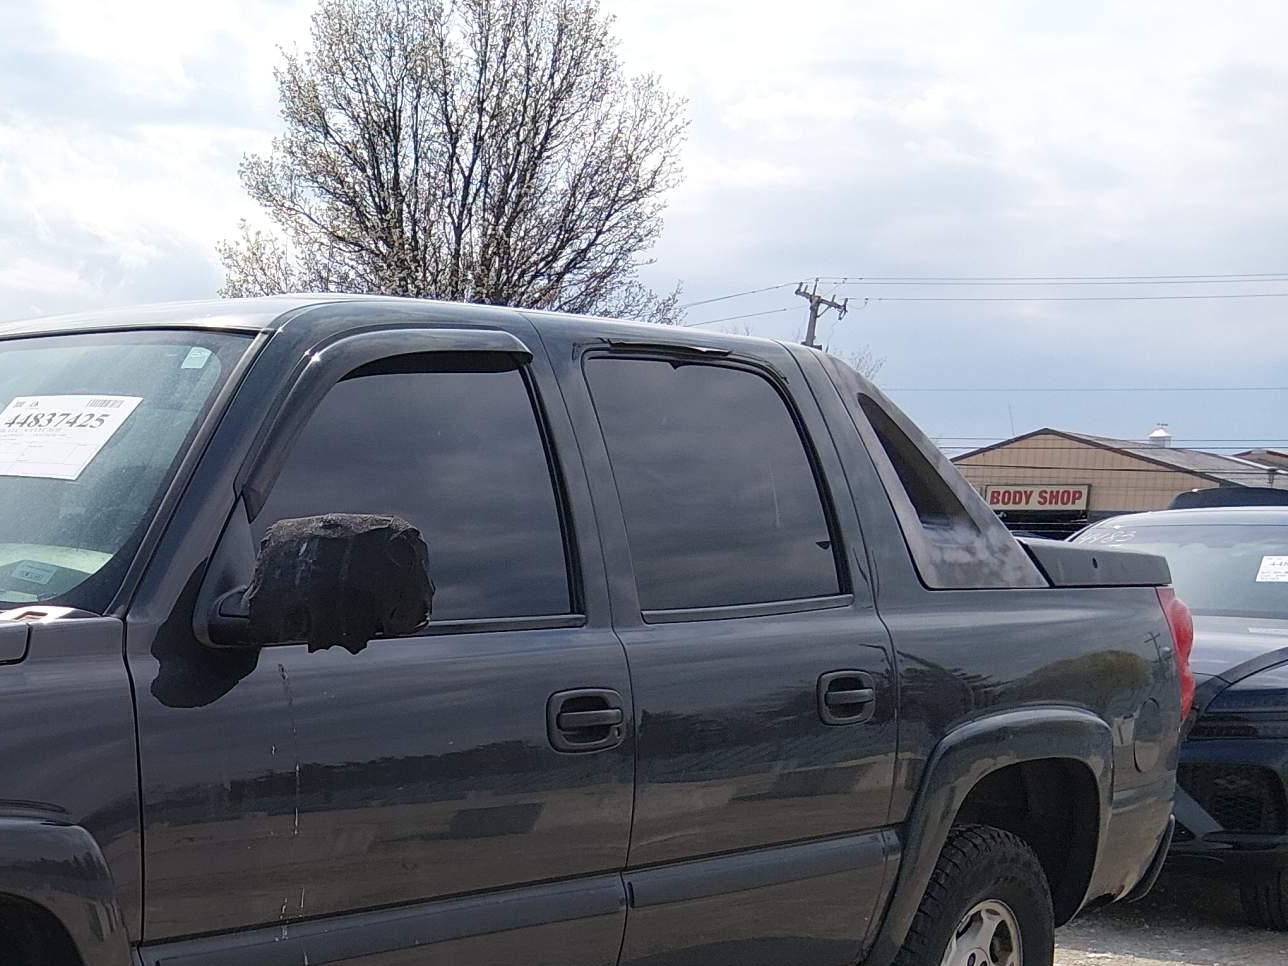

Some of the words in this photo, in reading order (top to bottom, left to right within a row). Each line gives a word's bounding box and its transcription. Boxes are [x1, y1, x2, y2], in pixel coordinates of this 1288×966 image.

[4, 412, 111, 429] 44837425
[989, 490, 1034, 505] BODY
[1037, 489, 1083, 506] SHOP
